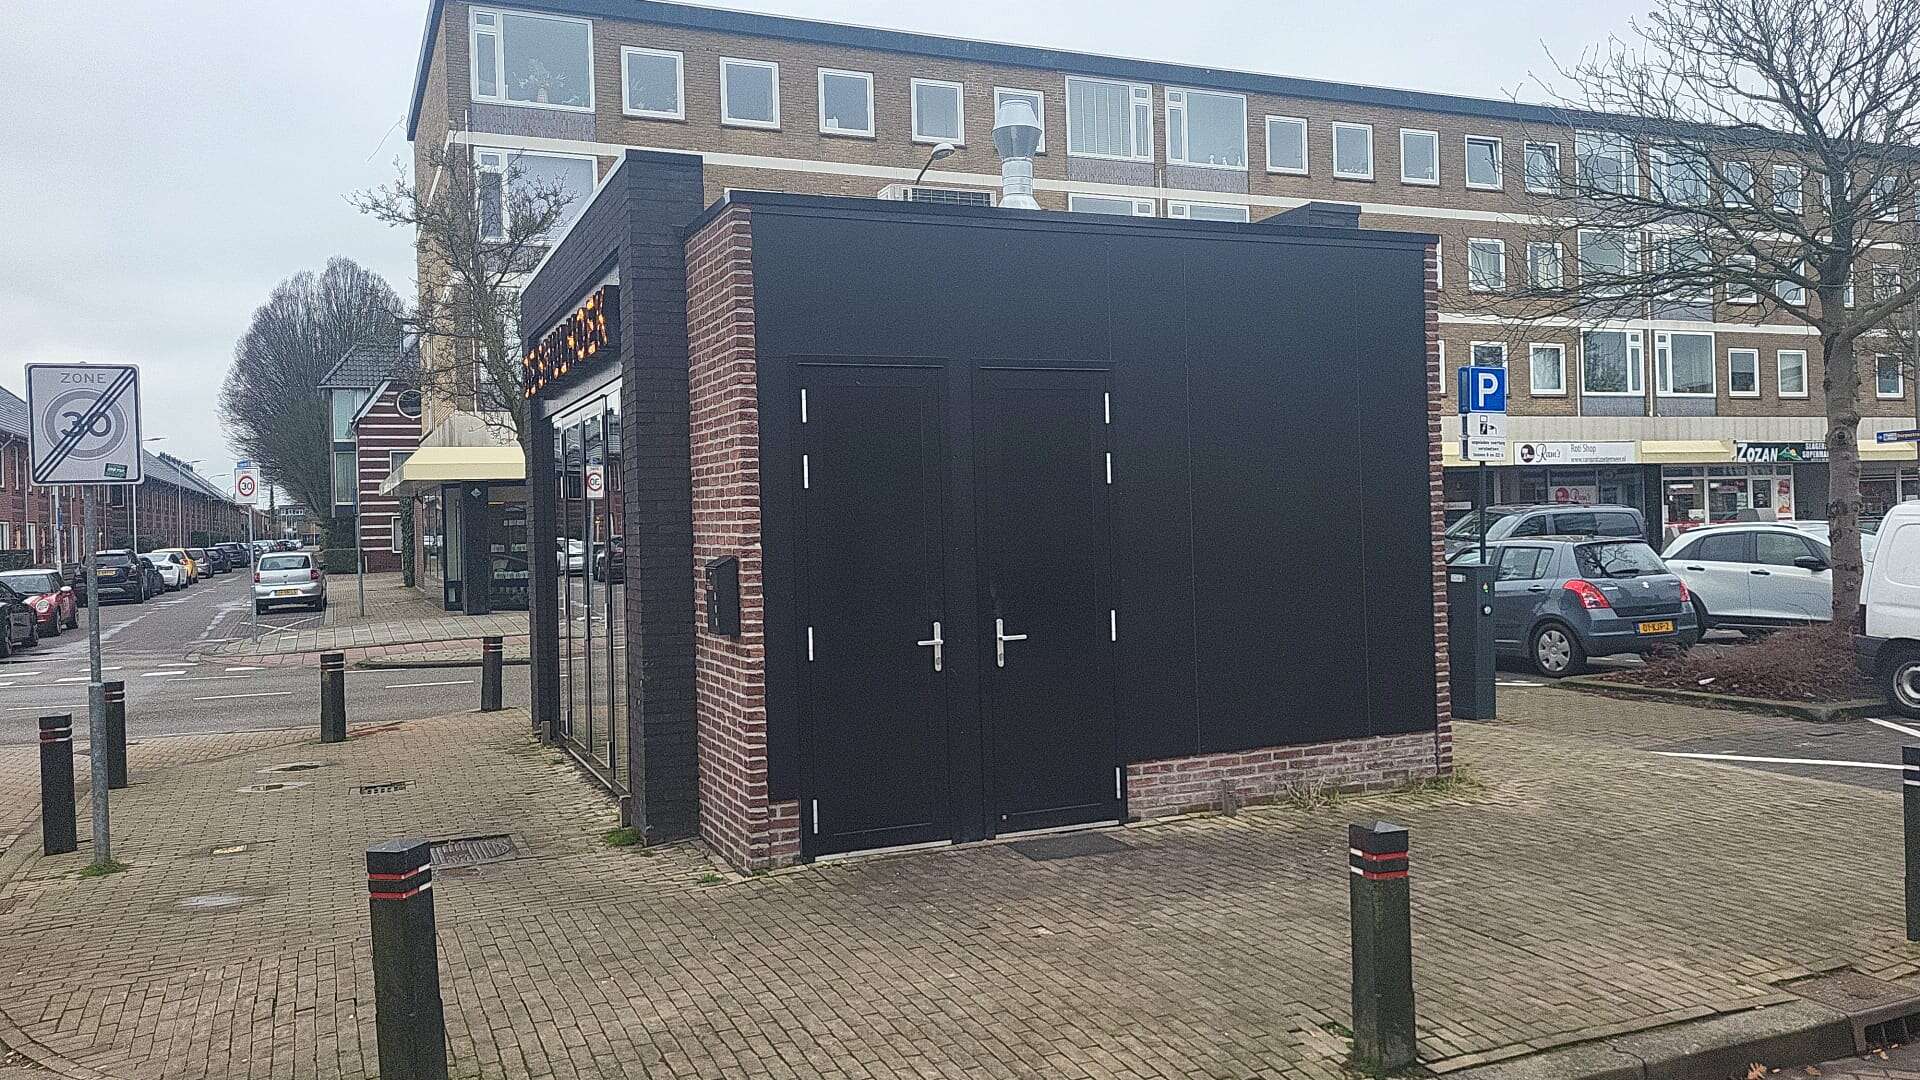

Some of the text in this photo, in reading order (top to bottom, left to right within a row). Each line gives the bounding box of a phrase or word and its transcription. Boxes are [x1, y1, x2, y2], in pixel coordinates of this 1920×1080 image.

[60, 372, 107, 384] ZONE
[1478, 372, 1499, 408] P
[61, 411, 112, 438] 30
[1582, 444, 1597, 455] Shop
[1804, 442, 1827, 450] SLAGER
[1737, 443, 1779, 463] ZOZAN
[1802, 451, 1830, 459] SUPERMA
[241, 481, 253, 491] 30
